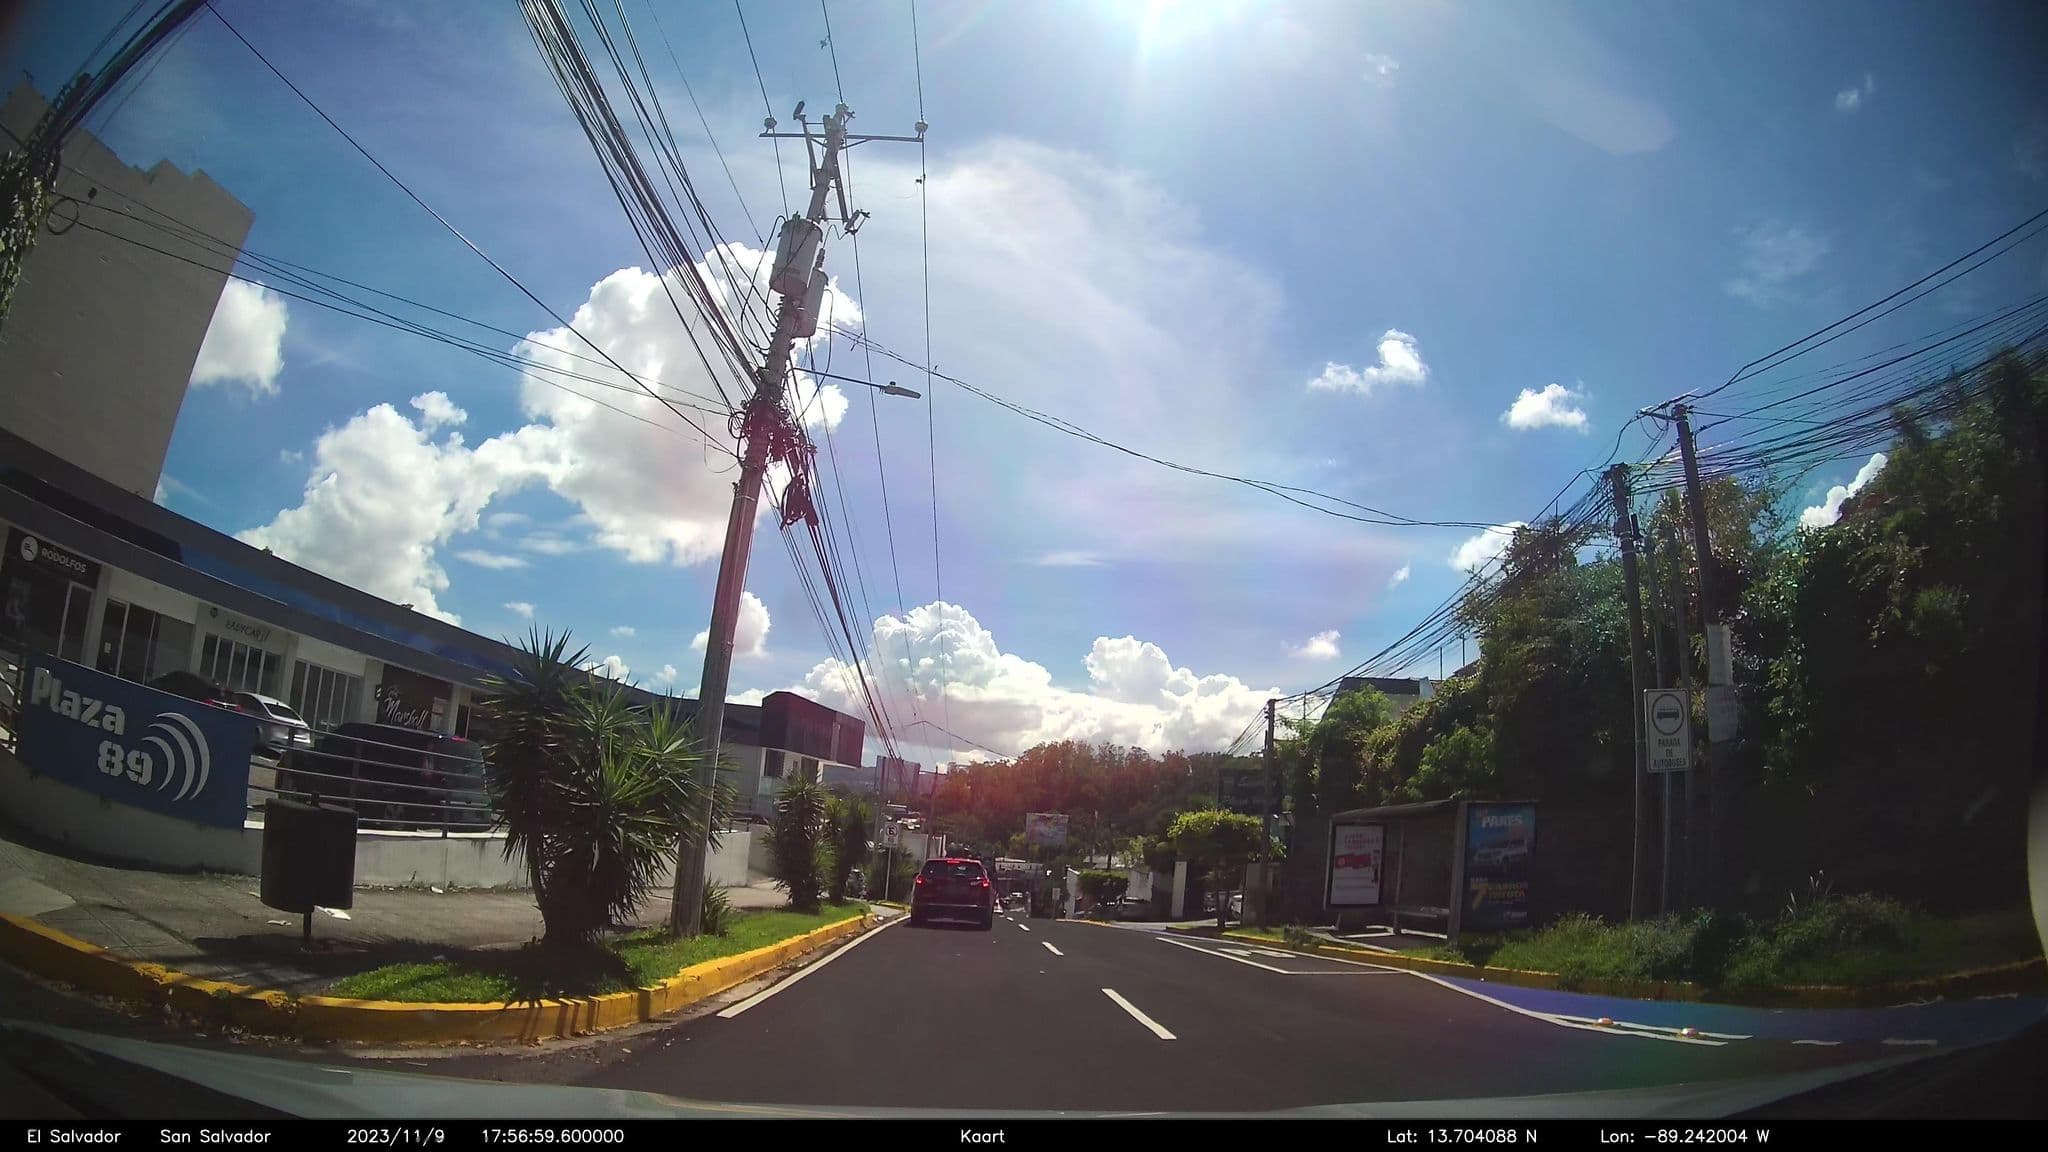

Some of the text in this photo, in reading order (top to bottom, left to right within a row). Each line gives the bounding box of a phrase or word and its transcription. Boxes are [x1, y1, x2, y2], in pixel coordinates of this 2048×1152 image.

[41, 547, 87, 574] RODOLFOS
[31, 666, 126, 735] Plaza
[97, 739, 153, 785] 89
